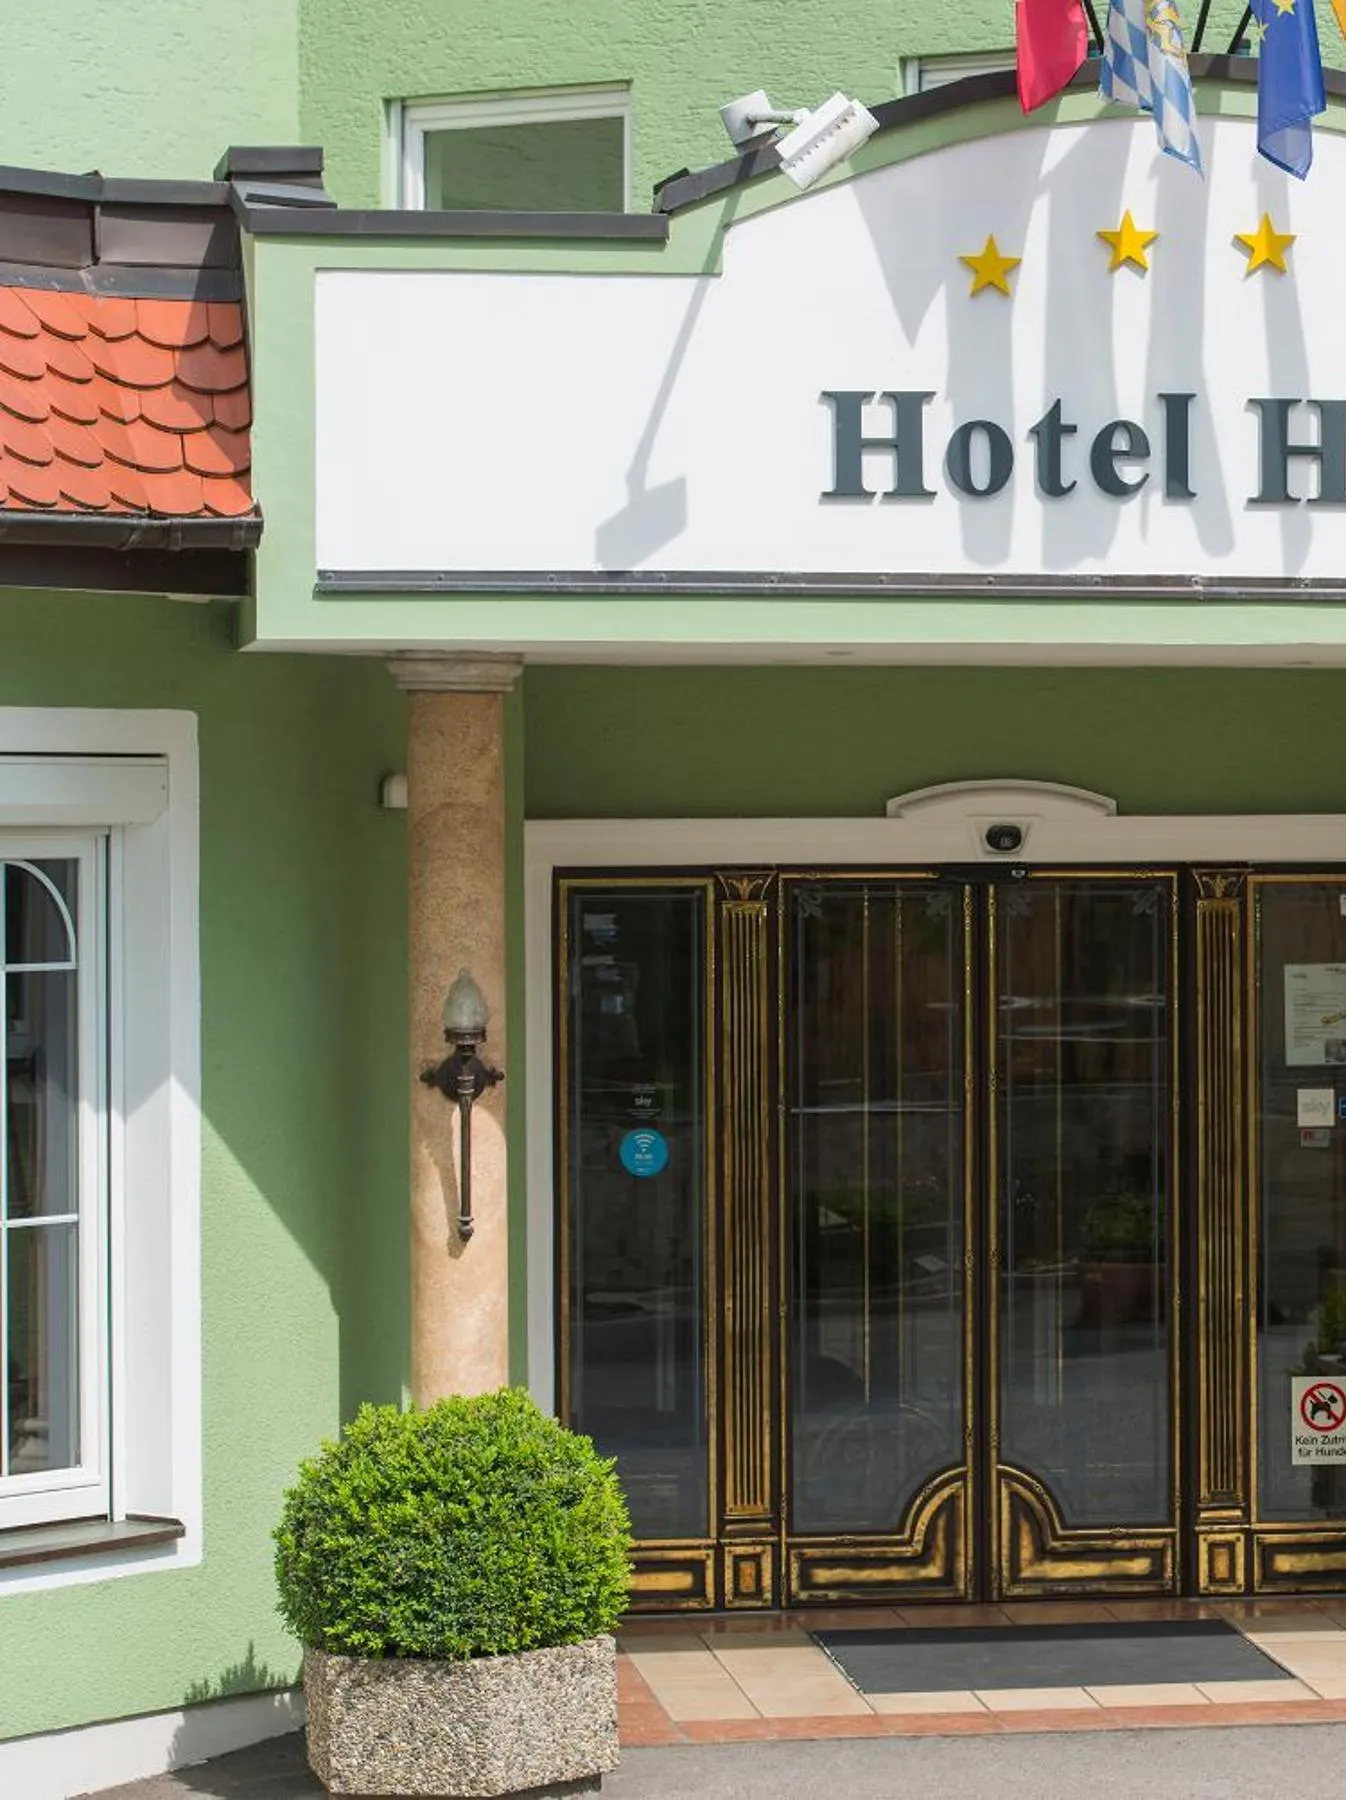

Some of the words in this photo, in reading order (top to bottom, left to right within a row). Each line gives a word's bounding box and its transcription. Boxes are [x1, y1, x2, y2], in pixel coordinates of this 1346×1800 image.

[819, 390, 1198, 499] Hotel
[1301, 1097, 1331, 1117] sky
[1295, 1435, 1318, 1445] Kein
[1298, 1448, 1313, 1457] für
